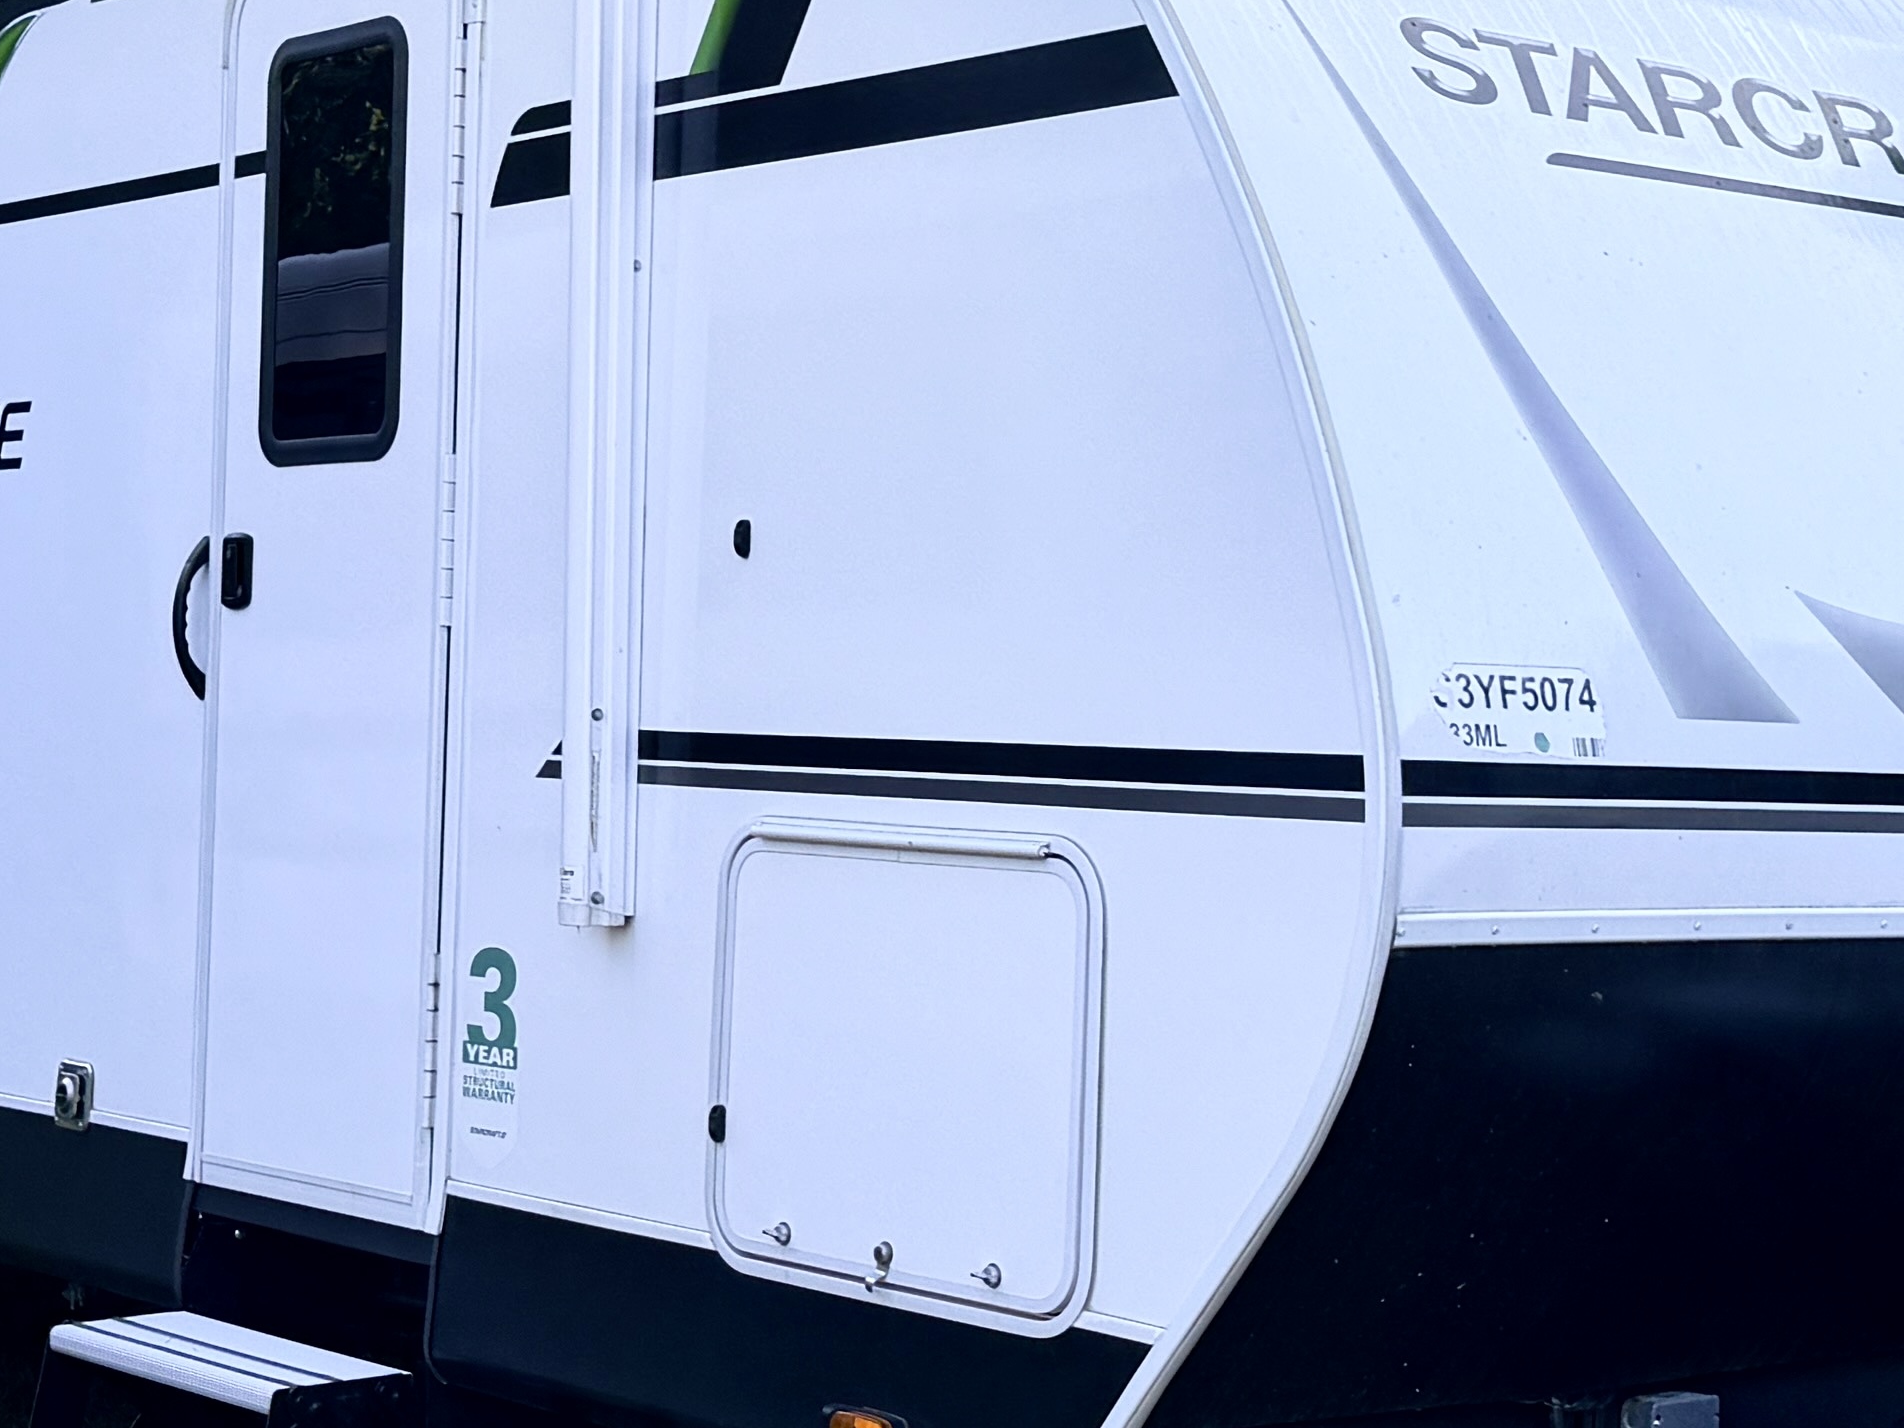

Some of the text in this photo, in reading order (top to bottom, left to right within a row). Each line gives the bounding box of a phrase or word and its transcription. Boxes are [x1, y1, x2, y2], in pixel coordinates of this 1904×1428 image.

[466, 947, 517, 1047] 3
[465, 1042, 515, 1067] YEAR
[462, 1074, 516, 1092] STRUCTURAL
[462, 1085, 516, 1105] WARRANTY
